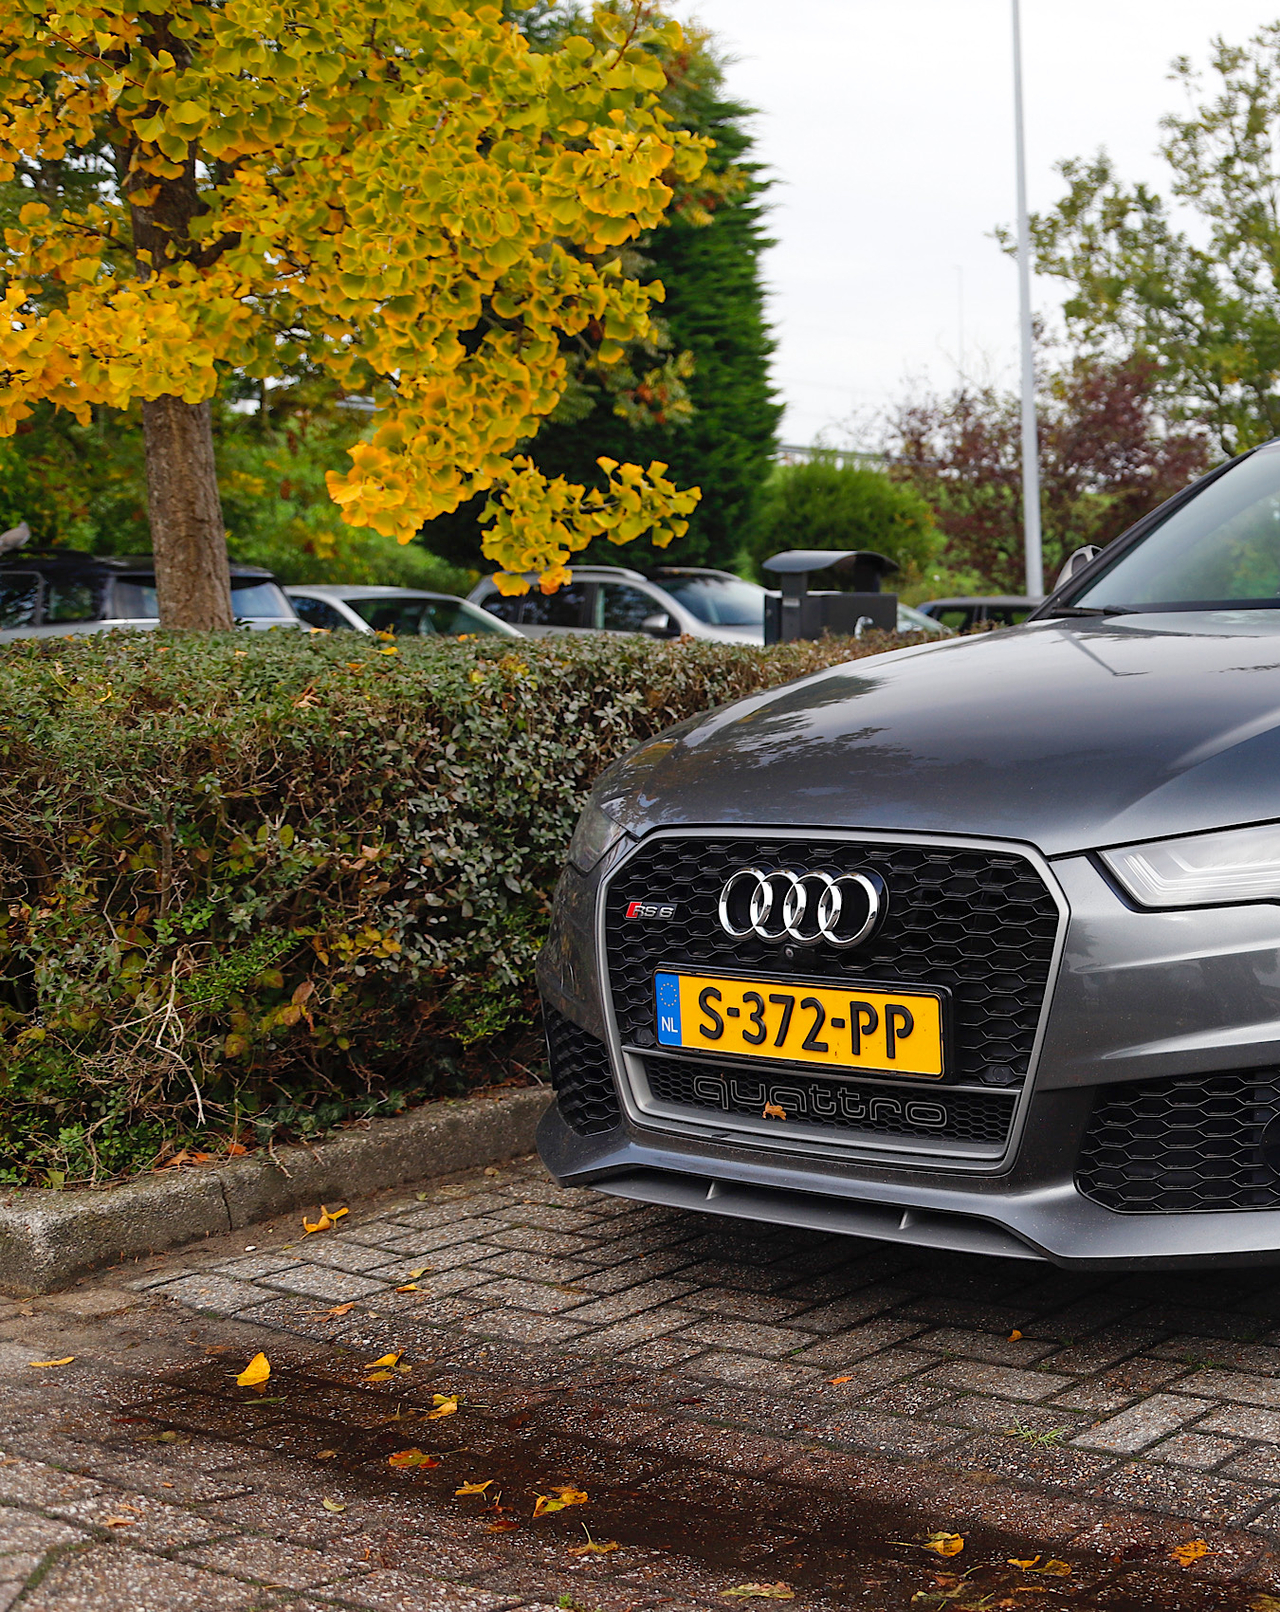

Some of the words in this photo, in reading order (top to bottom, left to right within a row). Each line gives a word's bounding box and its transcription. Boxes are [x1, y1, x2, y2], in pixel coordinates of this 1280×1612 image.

[661, 1016, 679, 1034] NL
[698, 986, 914, 1059] S-372-PP
[693, 1075, 948, 1128] quattro
